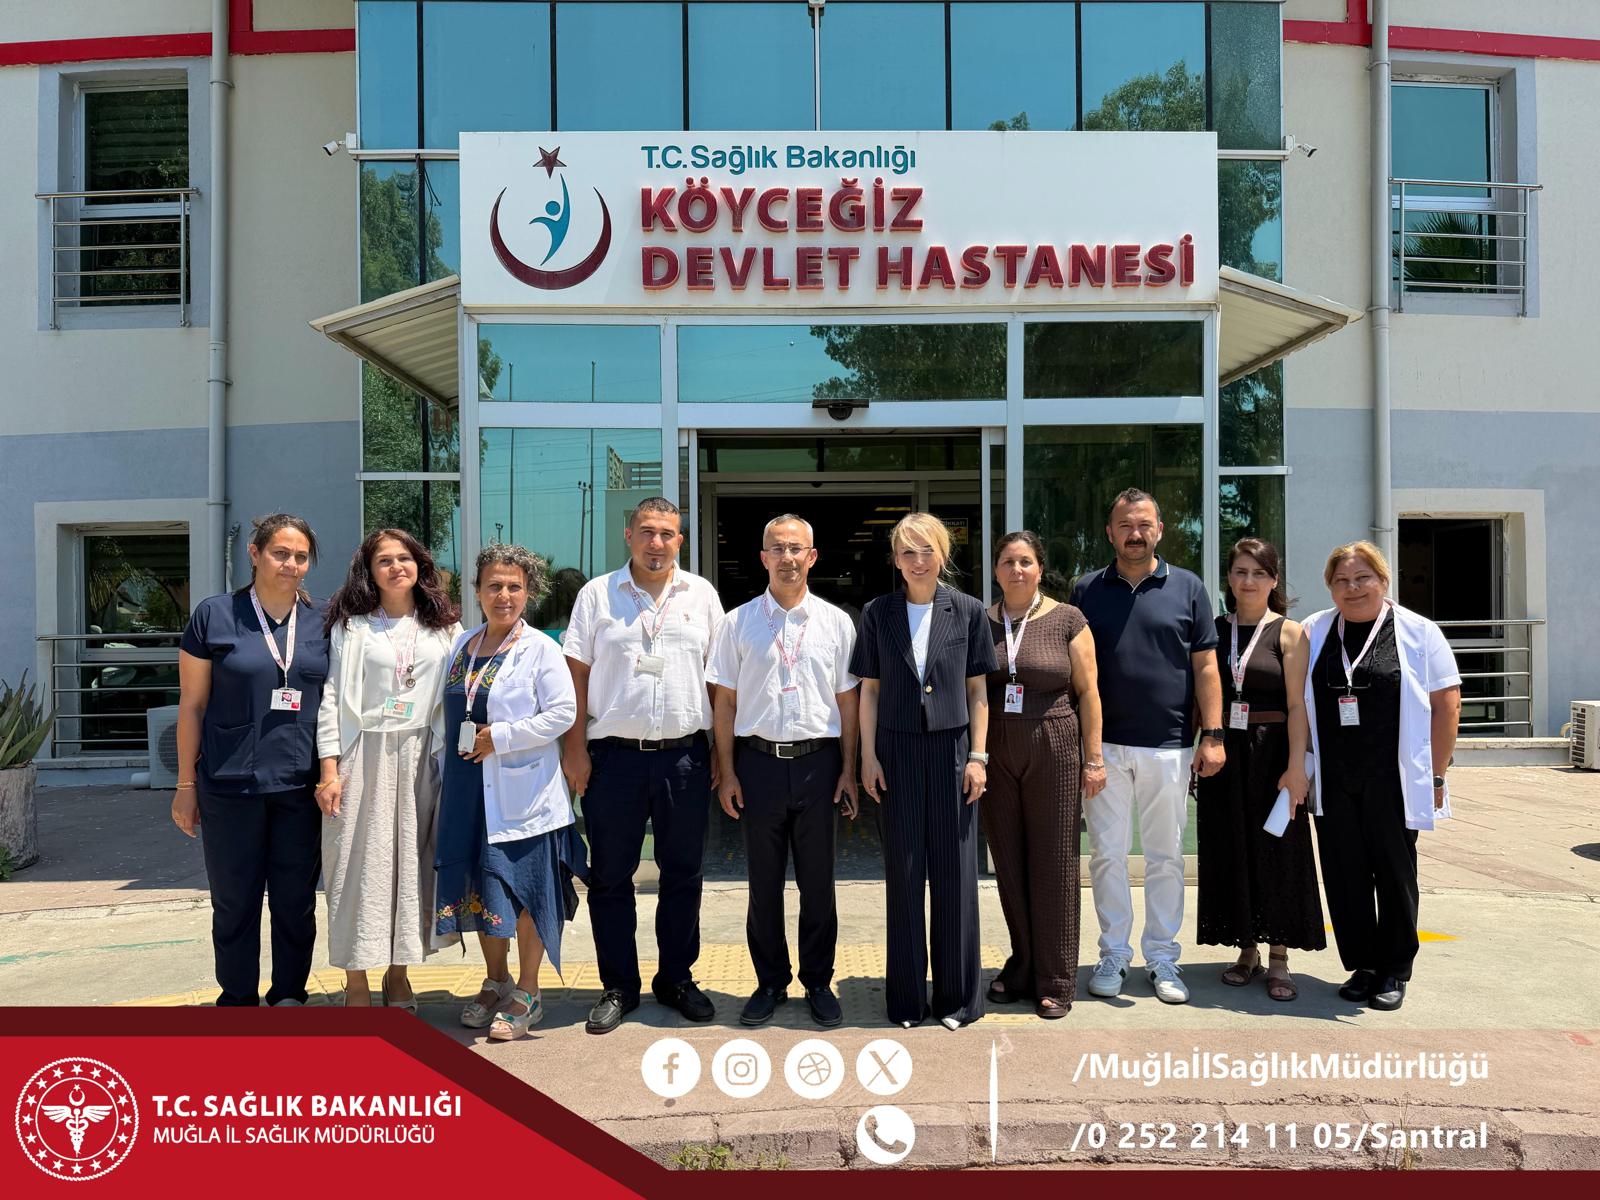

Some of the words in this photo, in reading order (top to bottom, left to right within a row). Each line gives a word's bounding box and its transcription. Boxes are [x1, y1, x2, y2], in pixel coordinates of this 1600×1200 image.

[786, 145, 916, 175] Bakanlığı
[641, 176, 923, 232] KÖYCEĞİZ
[641, 246, 860, 291] DEVLET
[877, 233, 1194, 291] HASTANESİ
